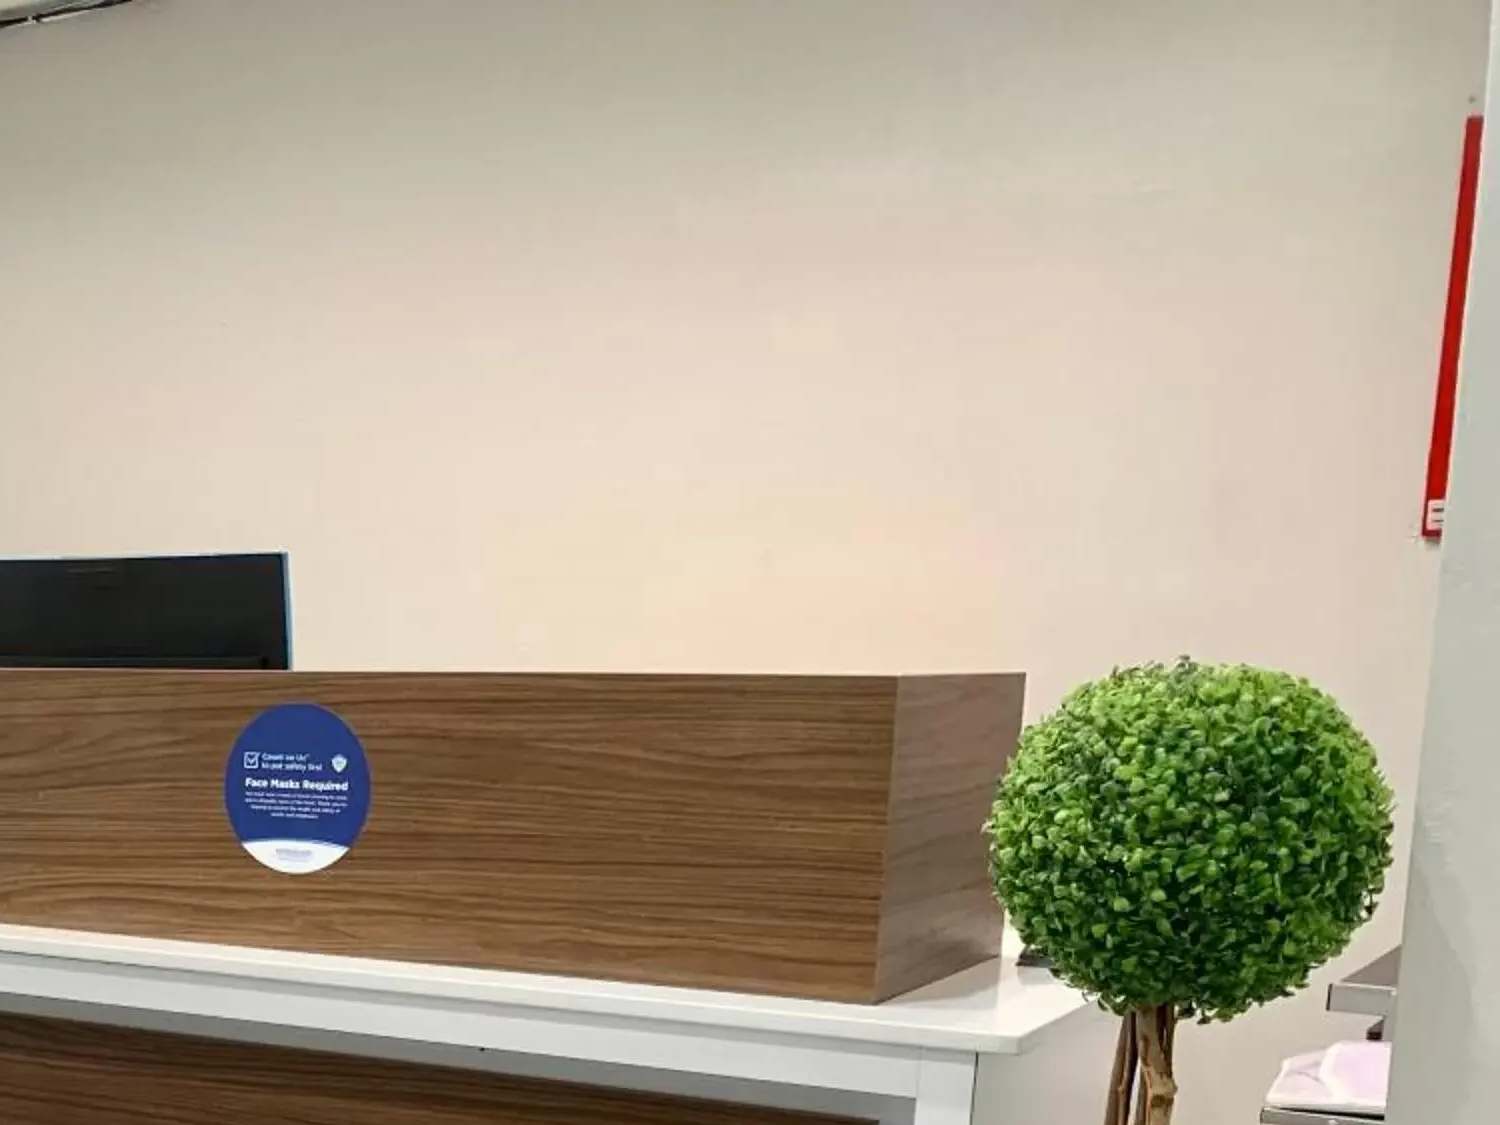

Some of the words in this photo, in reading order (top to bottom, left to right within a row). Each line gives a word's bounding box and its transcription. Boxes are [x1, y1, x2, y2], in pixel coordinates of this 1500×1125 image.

[245, 777, 268, 787] Face
[270, 779, 300, 789] Masks
[302, 780, 348, 792] Required
